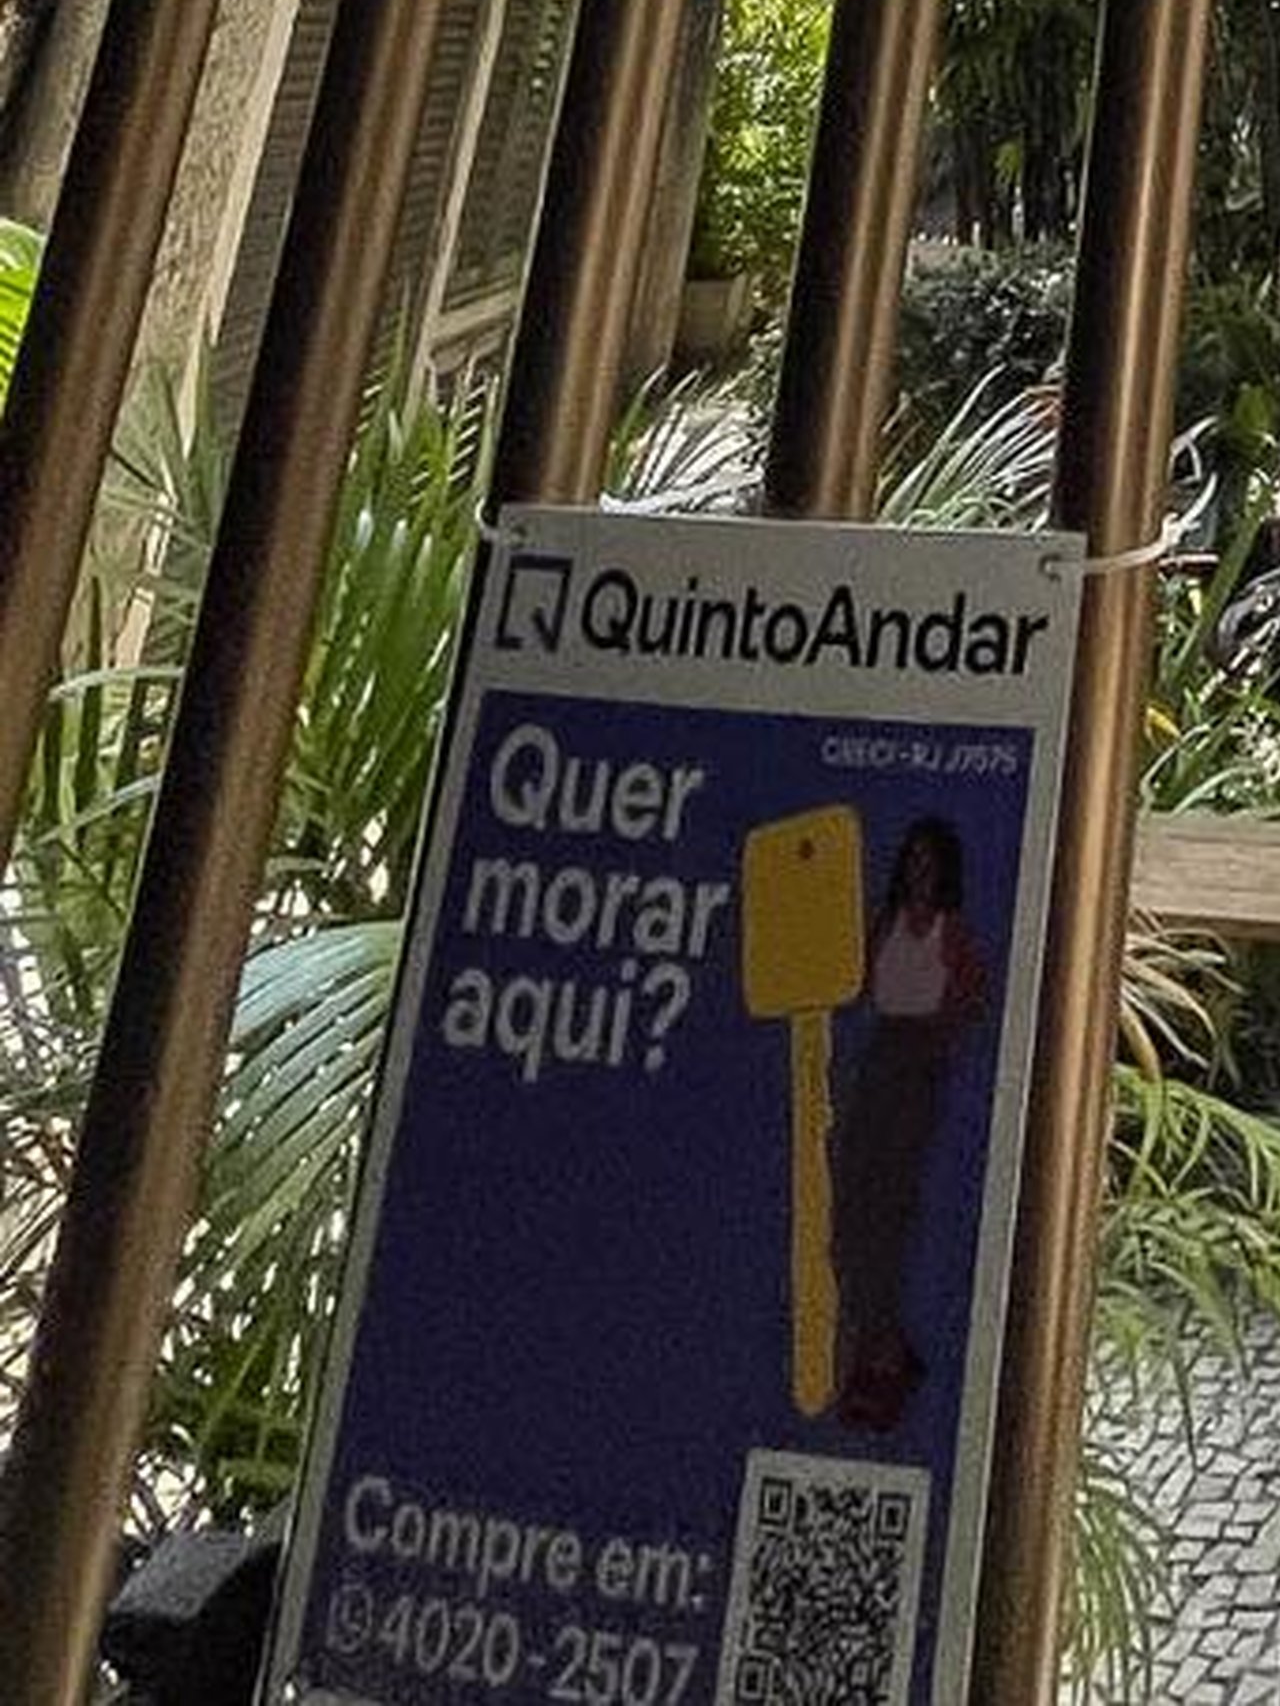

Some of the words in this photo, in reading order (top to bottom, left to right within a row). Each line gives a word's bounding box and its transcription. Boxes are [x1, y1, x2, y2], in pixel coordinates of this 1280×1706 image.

[579, 567, 1050, 676] QuintoAndar
[490, 723, 704, 839] Quer
[461, 858, 731, 957] morar
[444, 958, 691, 1083] aqui?
[344, 1475, 583, 1596] Compre
[599, 1535, 710, 1609] em:
[381, 1593, 699, 1706] 4020-2507
